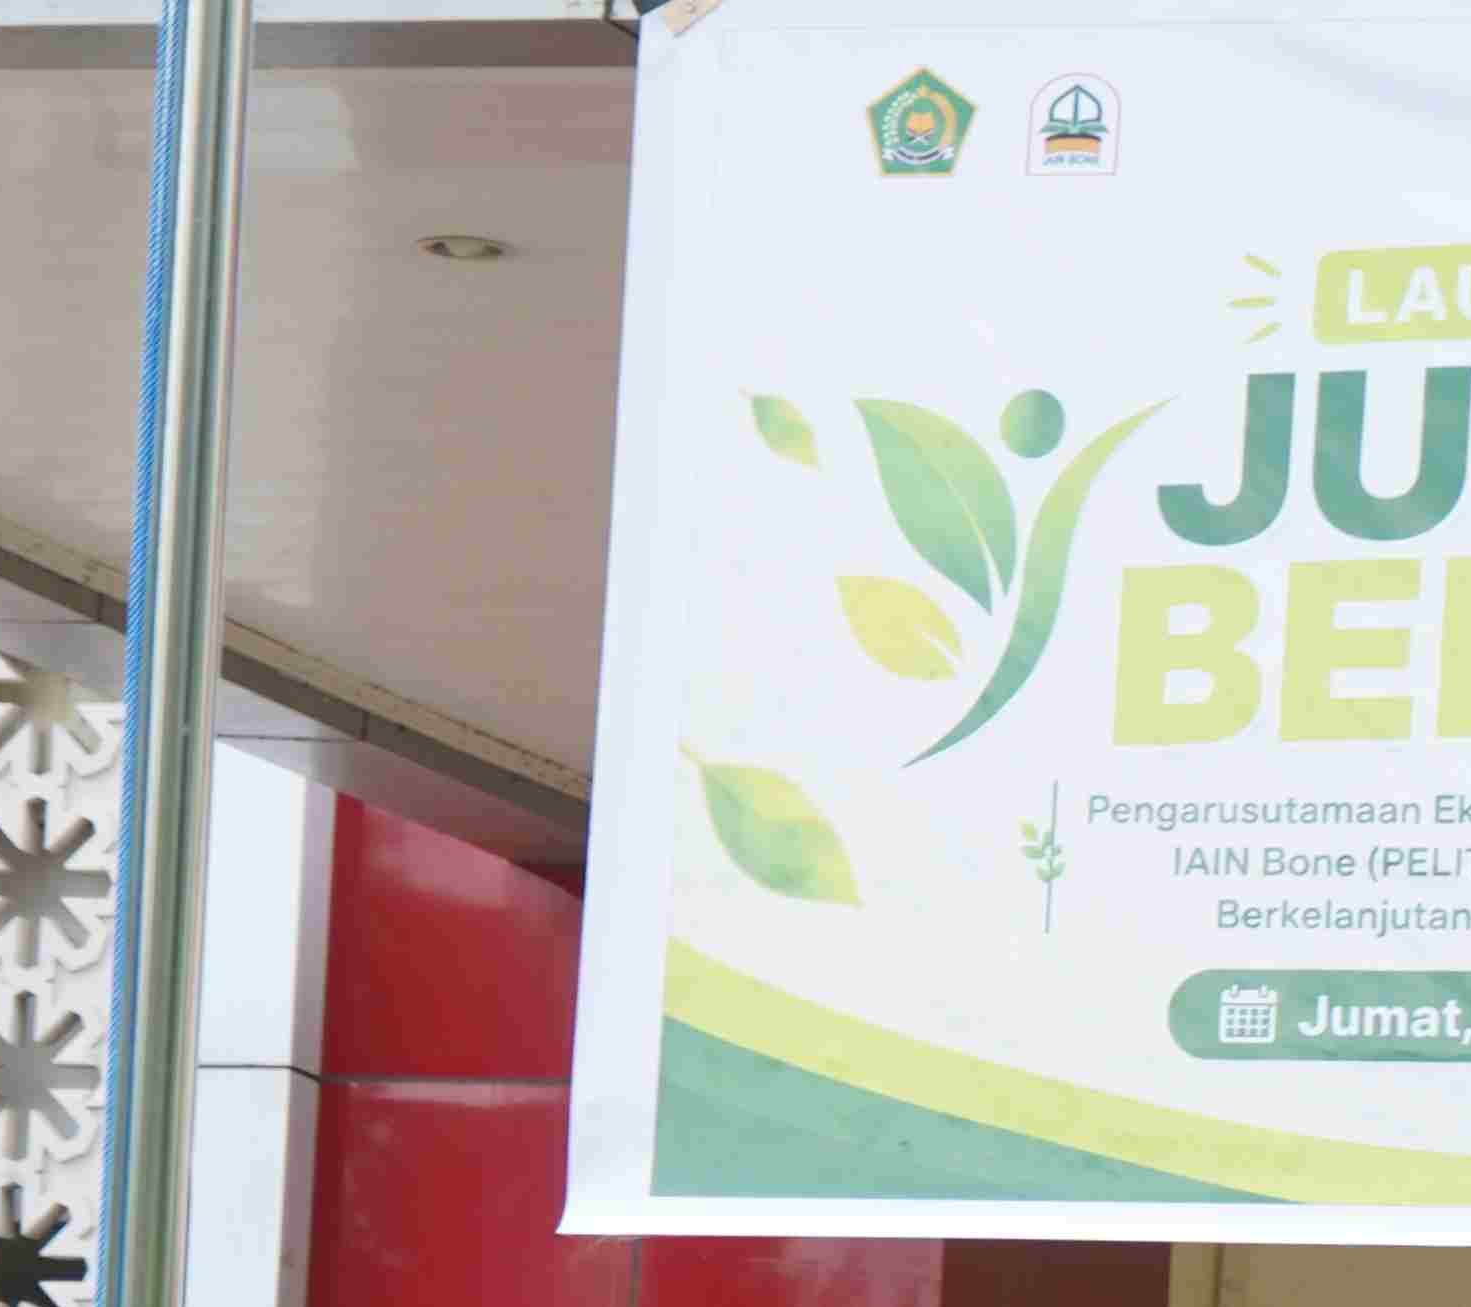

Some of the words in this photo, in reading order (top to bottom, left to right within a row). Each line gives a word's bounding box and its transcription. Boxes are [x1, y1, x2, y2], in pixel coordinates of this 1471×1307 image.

[1087, 794, 1423, 834] Pengarusutamaan
[1173, 847, 1251, 878] IAIN
[1262, 847, 1359, 879] Bone
